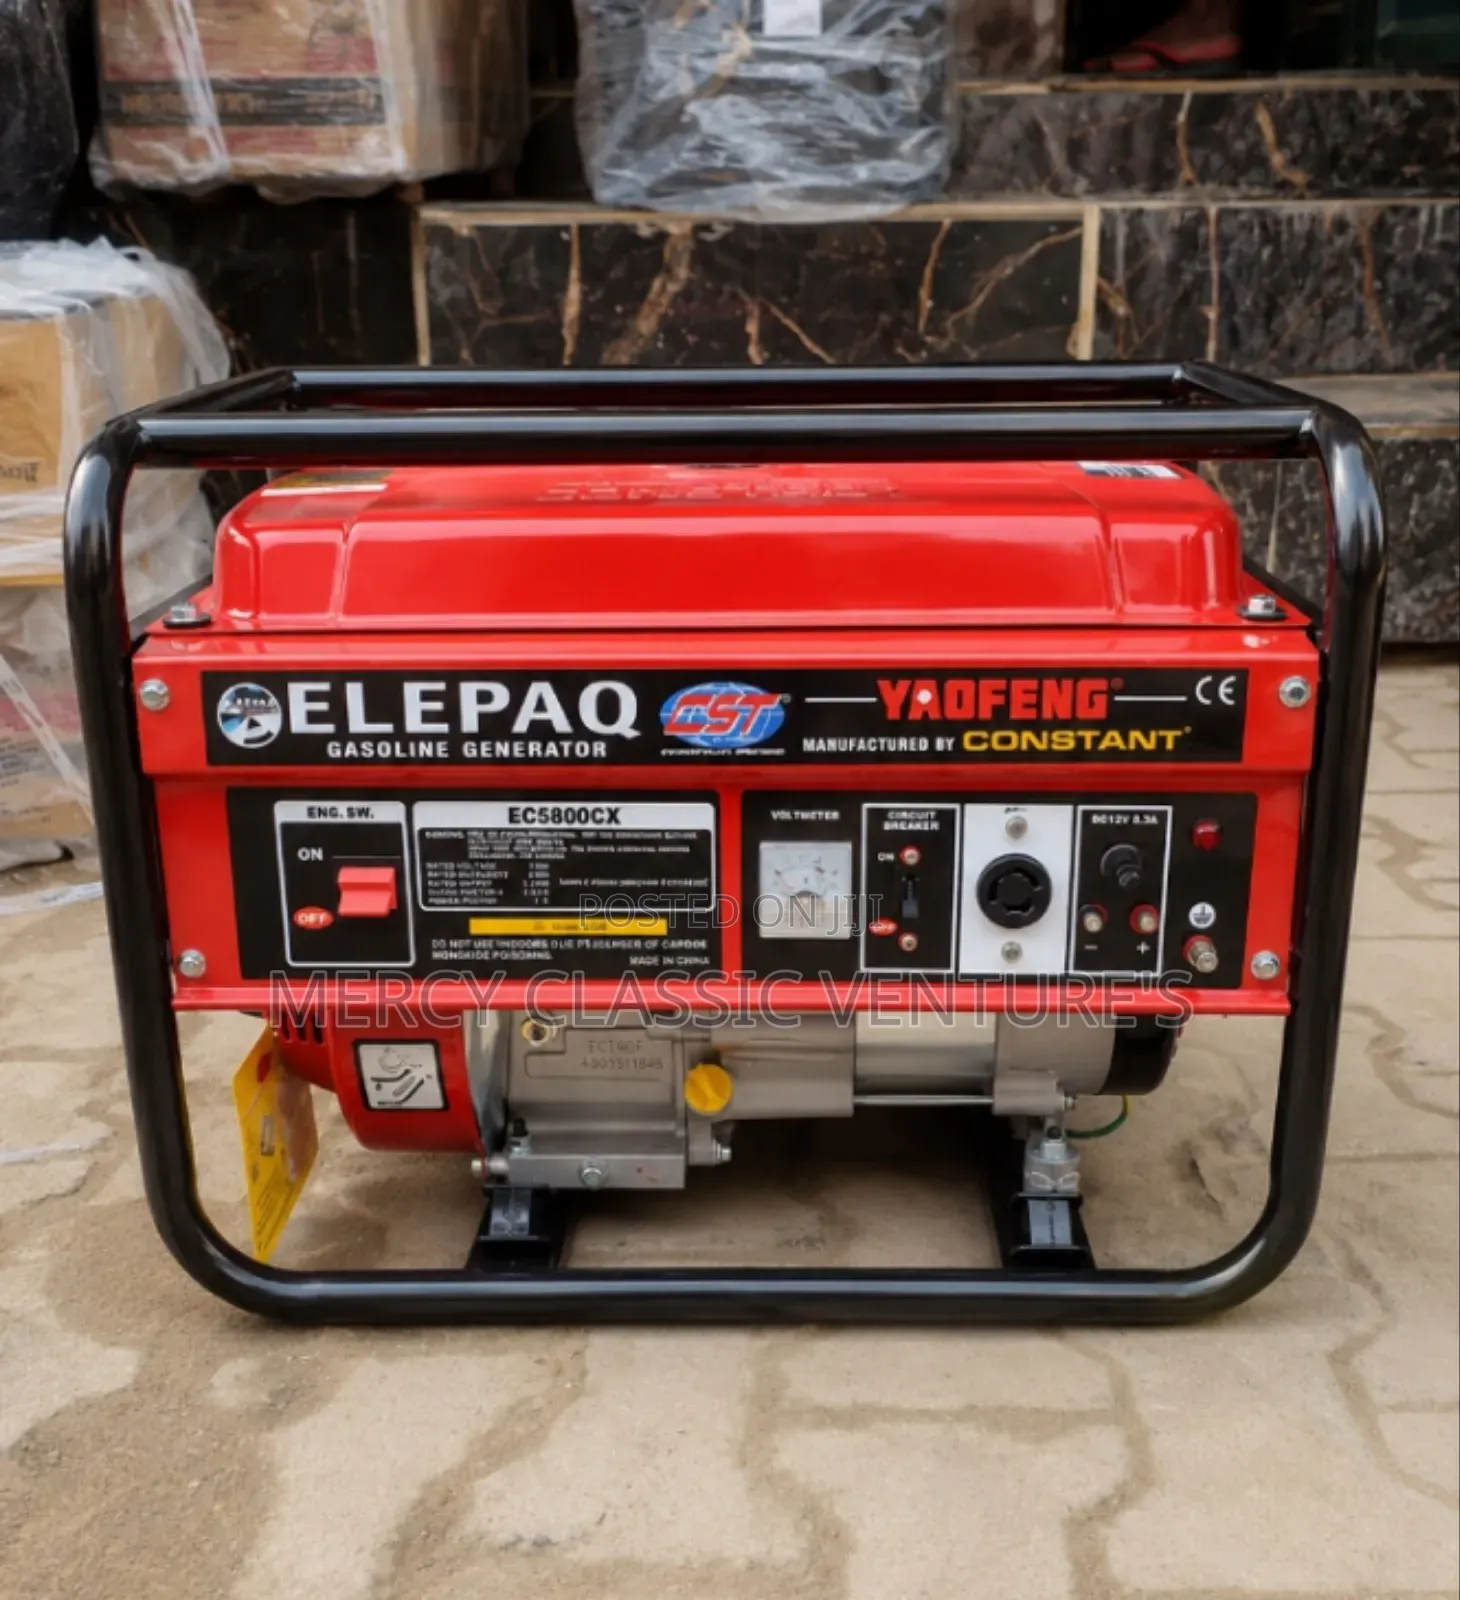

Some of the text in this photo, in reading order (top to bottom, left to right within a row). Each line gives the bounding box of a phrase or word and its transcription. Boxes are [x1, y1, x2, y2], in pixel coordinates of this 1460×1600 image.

[1195, 676, 1236, 705] CE
[877, 679, 1108, 720] YAOFENG
[287, 680, 641, 739] ELEPAQ
[663, 693, 781, 736] CST
[327, 741, 608, 758] GASOLINE GENERATOR
[803, 737, 930, 752] MANUFACTURED
[935, 736, 954, 752] BY
[963, 730, 1182, 751] CONSTANT
[508, 807, 621, 825] EC5800CX
[771, 810, 840, 821] VOLTMETER
[887, 811, 937, 820] CIRCUIT
[883, 821, 939, 831] BREAKER
[297, 847, 323, 861] ON
[878, 852, 895, 862] ON
